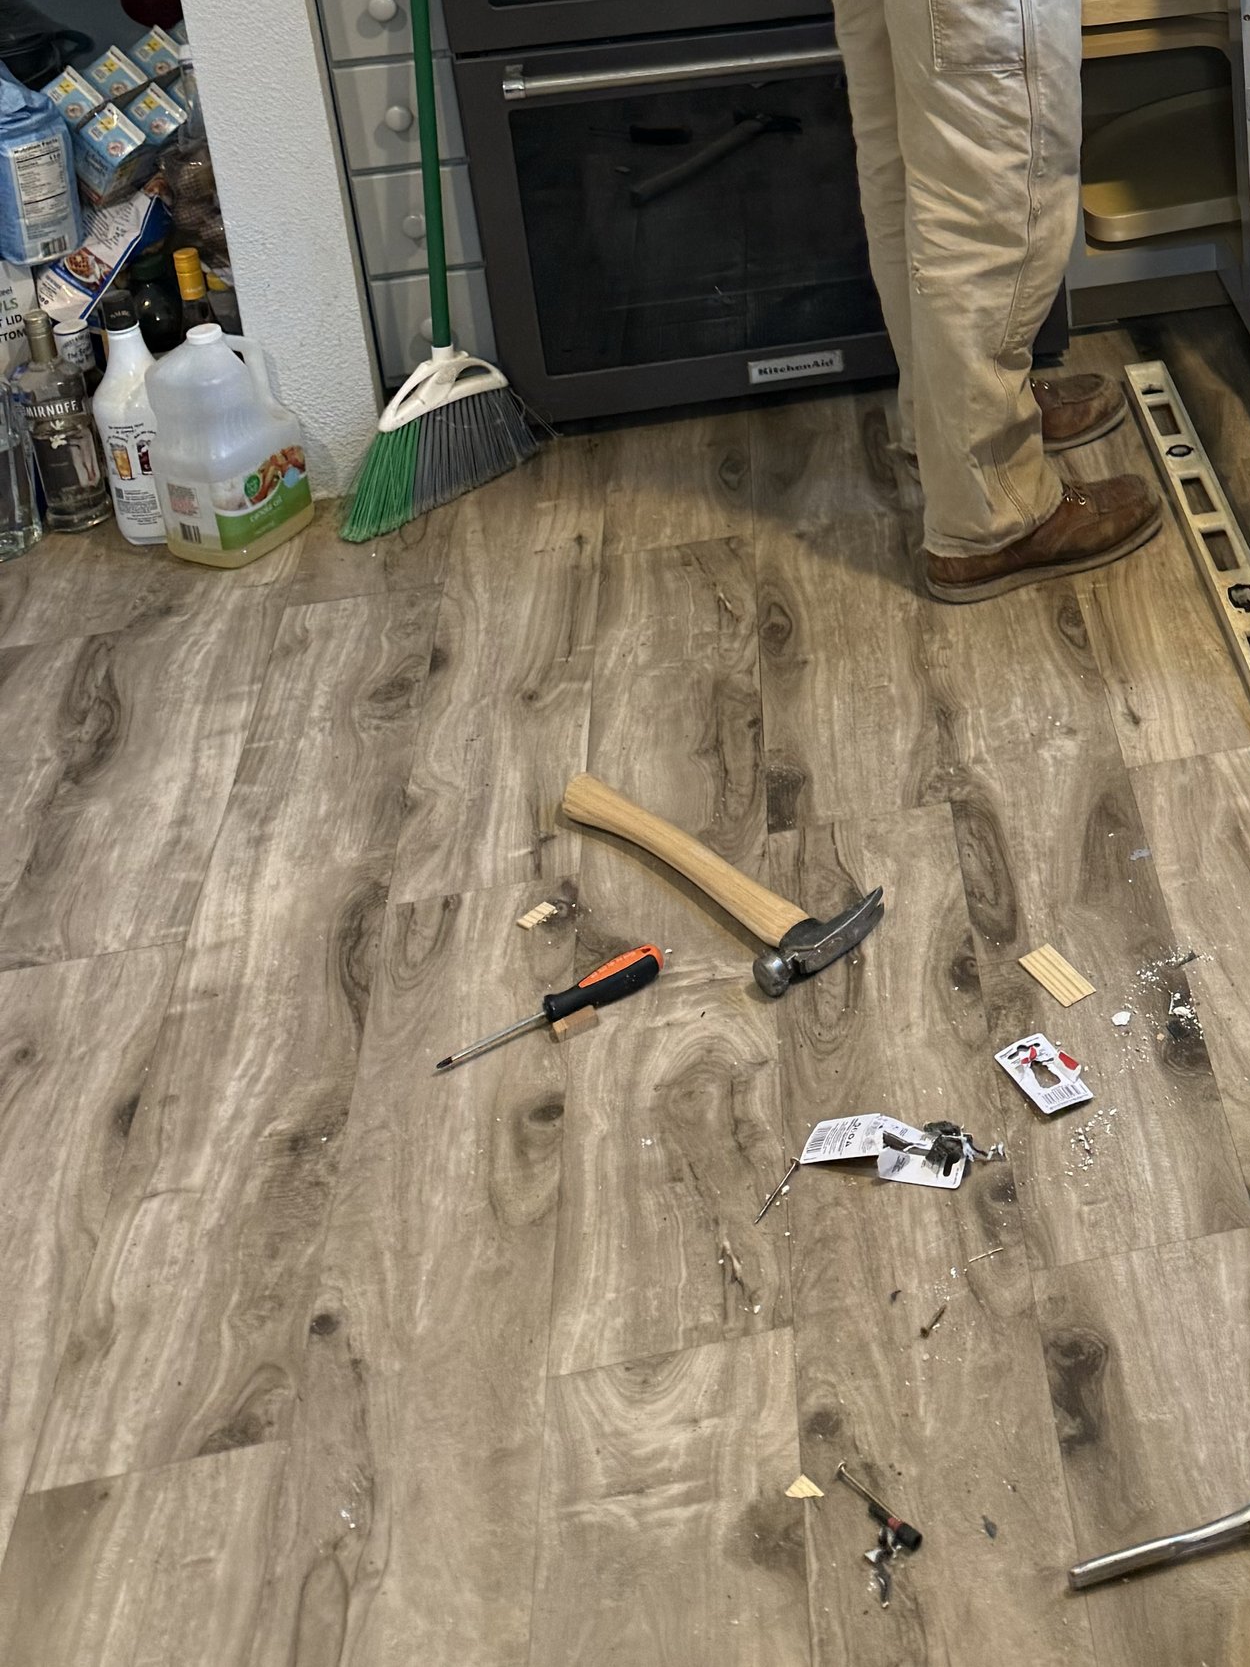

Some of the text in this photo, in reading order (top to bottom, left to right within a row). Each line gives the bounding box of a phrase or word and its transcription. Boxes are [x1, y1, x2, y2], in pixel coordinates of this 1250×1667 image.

[6, 314, 22, 326] LID
[758, 358, 834, 375] KitchenAid
[25, 399, 77, 418] MIRNOFF
